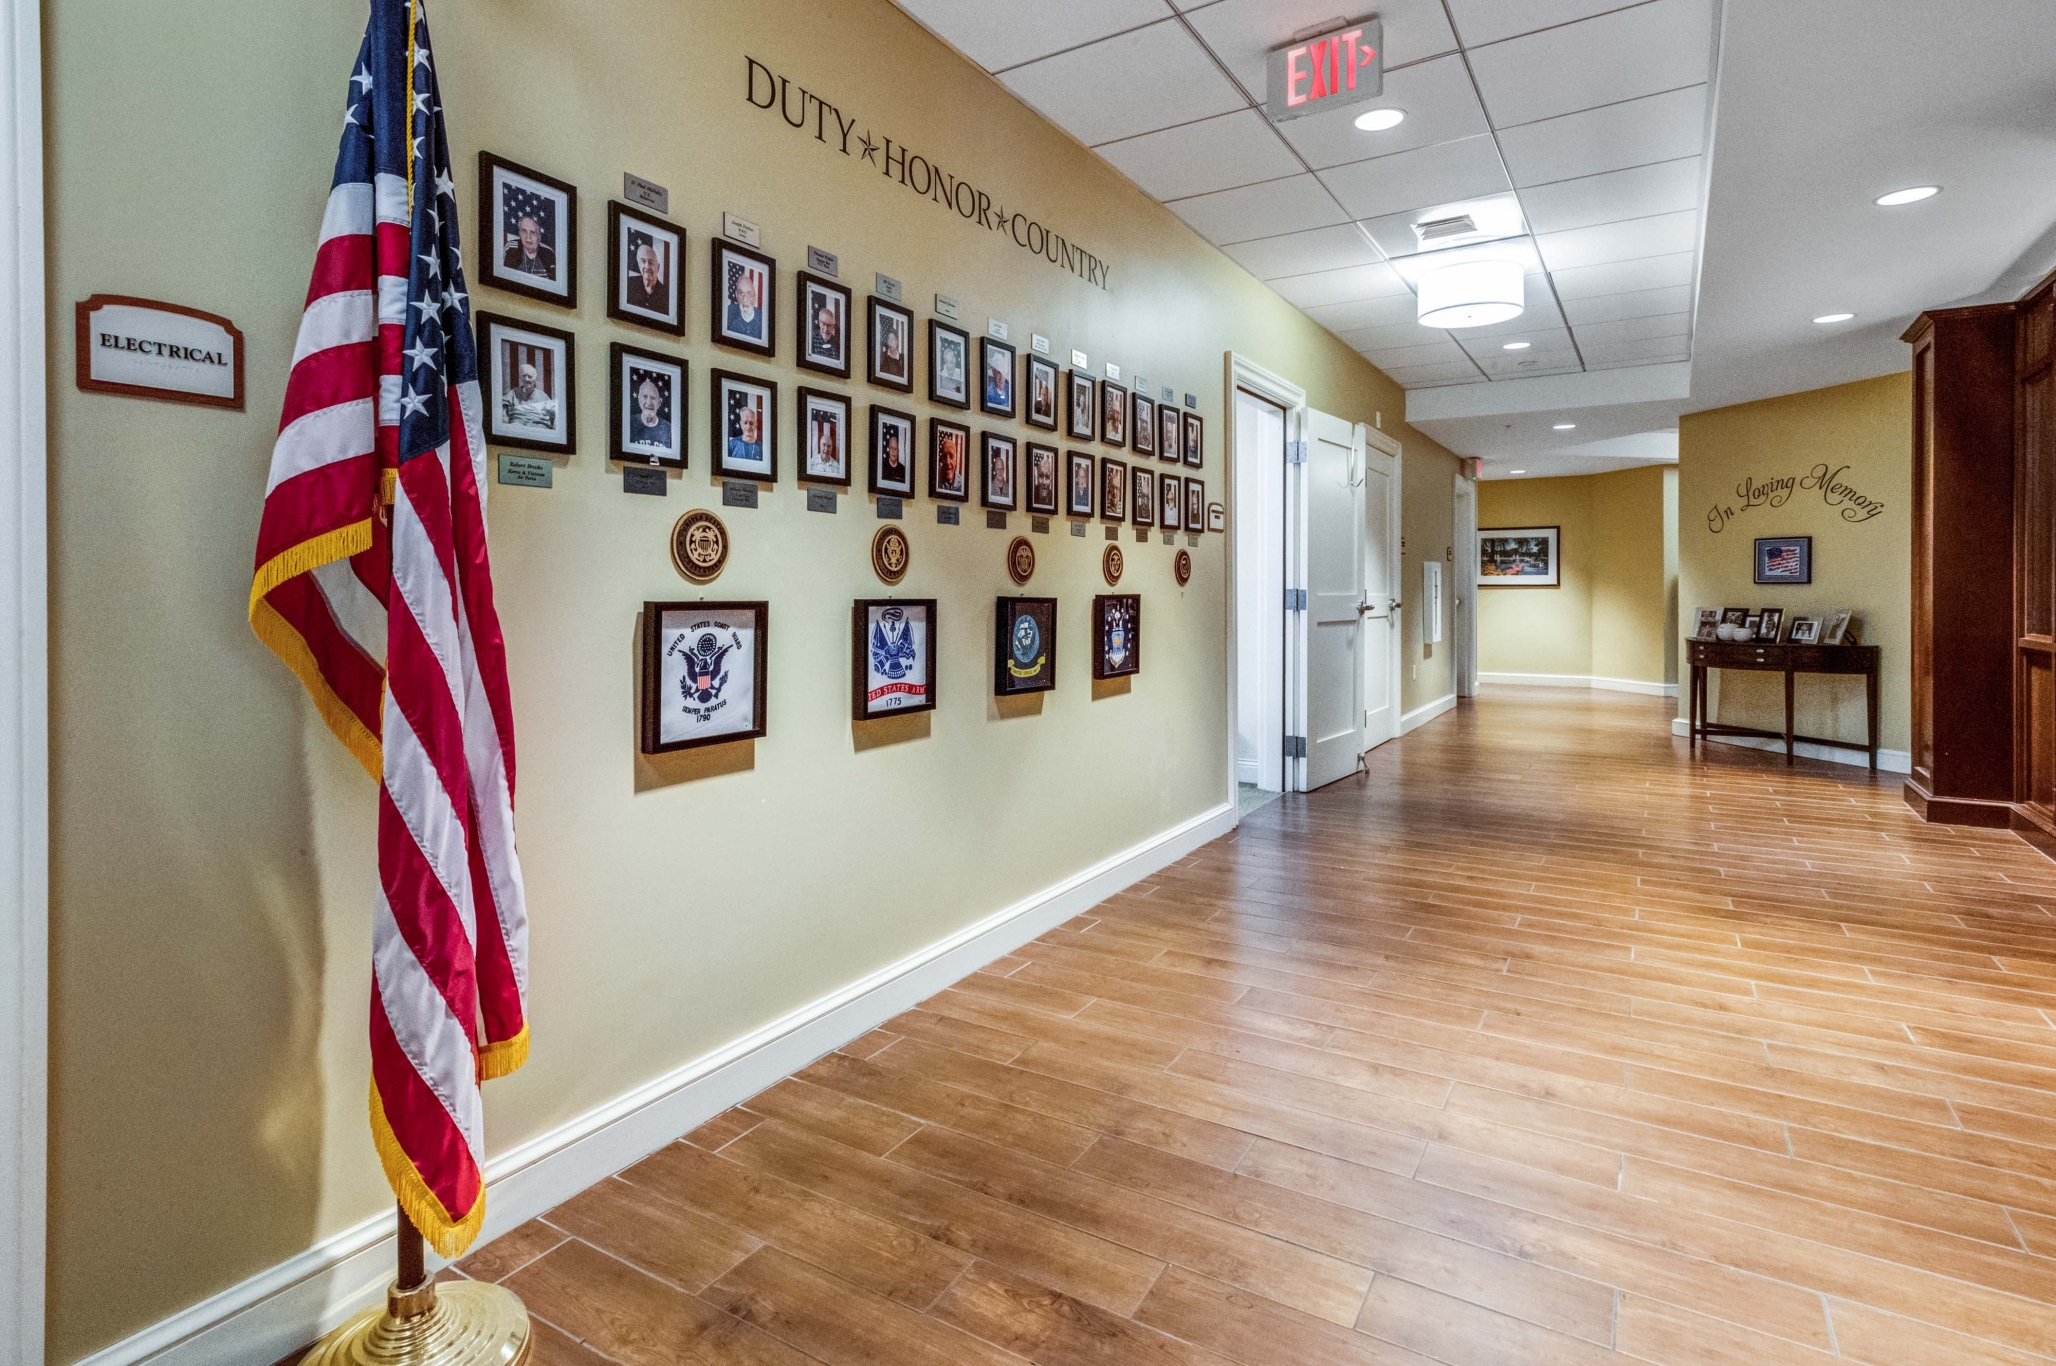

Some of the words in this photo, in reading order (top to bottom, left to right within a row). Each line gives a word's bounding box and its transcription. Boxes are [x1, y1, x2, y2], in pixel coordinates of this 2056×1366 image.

[1286, 28, 1363, 108] EXIT
[744, 54, 856, 156] DUTY
[881, 135, 992, 231] HONOR
[1010, 213, 1110, 292] COUNTRY
[99, 332, 228, 366] ELECTRICAL
[1707, 505, 1735, 534] In
[1736, 476, 1797, 512] Loving
[1799, 463, 1885, 523] Memory
[667, 633, 686, 657] UNITED
[690, 620, 711, 633] STATES
[713, 620, 731, 632] COAST
[681, 705, 702, 715] SEMPER
[704, 698, 728, 714] PARATUS
[883, 684, 908, 695] STATES
[886, 697, 902, 708] 1775
[696, 713, 711, 723] 1790
